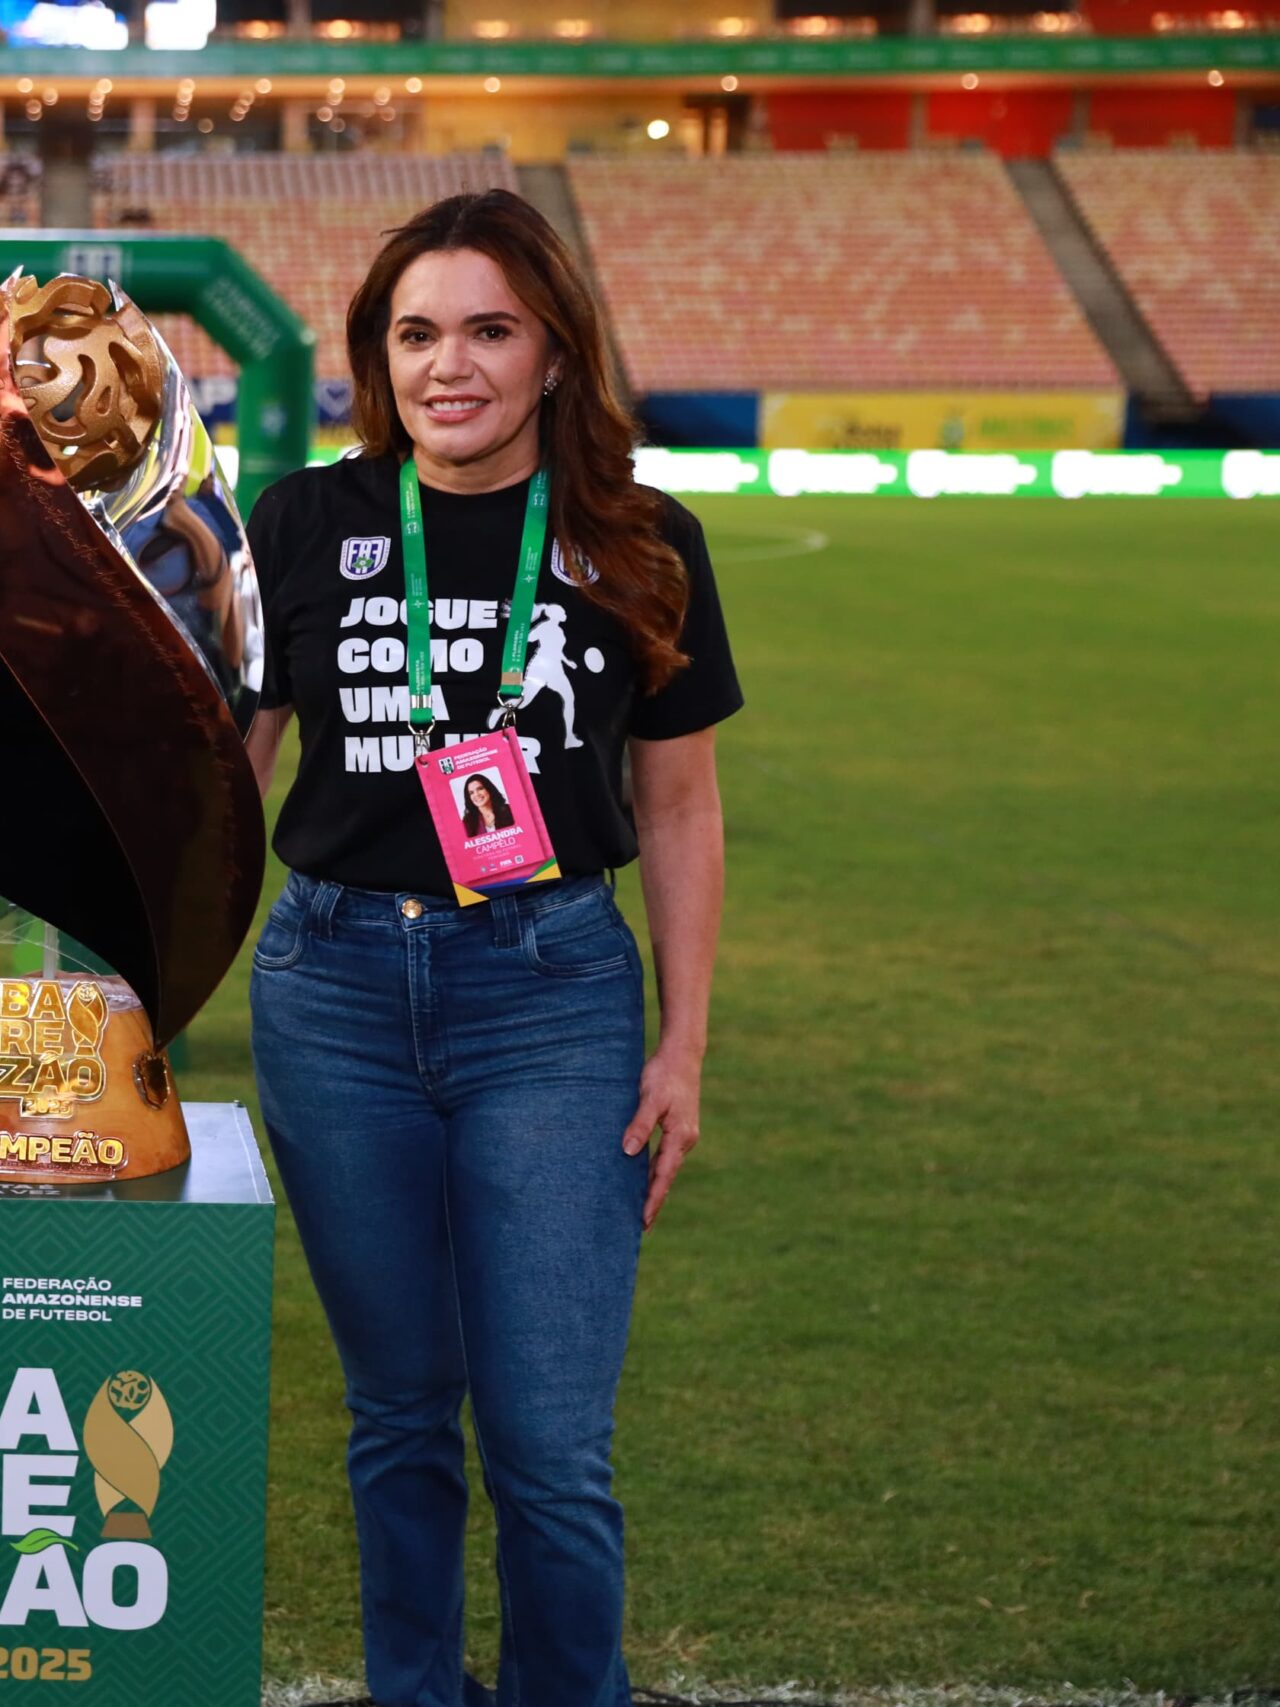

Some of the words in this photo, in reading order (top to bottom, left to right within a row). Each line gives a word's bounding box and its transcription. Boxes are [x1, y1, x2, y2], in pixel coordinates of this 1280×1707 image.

[345, 733, 541, 775] MUR
[464, 826, 524, 849] ALESSANDRA
[2, 1277, 112, 1293] FEDERAÇÃO
[2, 1293, 143, 1307] AMAZONENSE
[2, 1308, 26, 1320] DE
[29, 1309, 112, 1322] FUTEBOL
